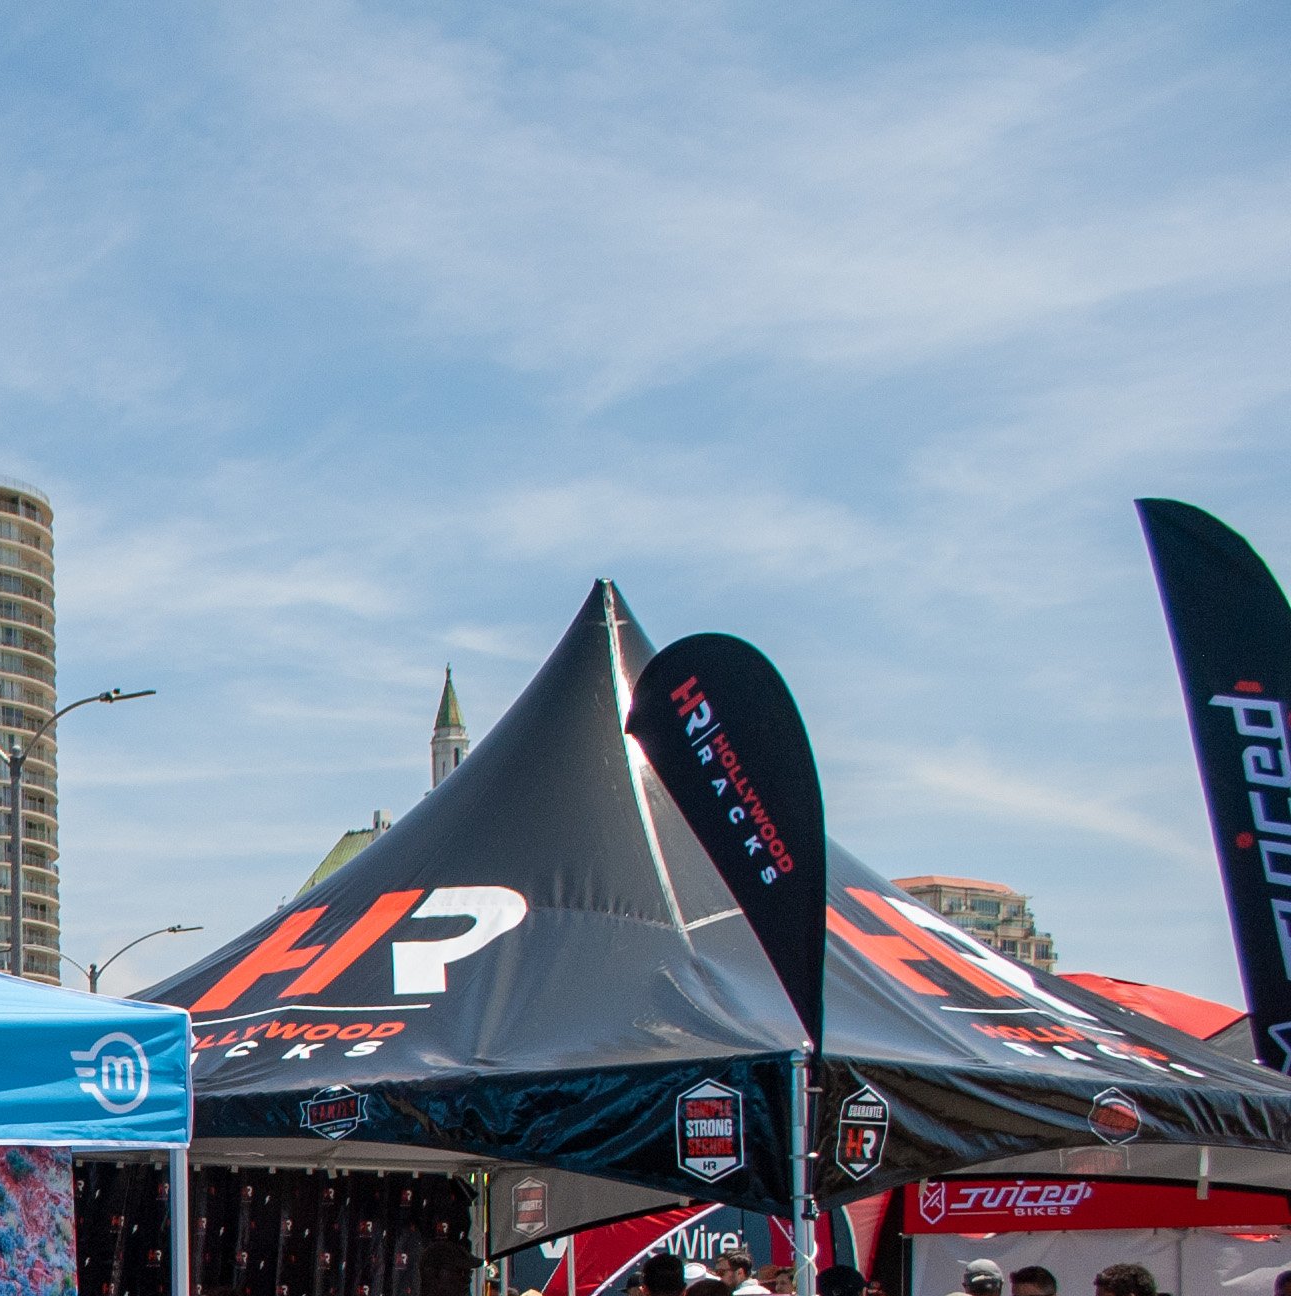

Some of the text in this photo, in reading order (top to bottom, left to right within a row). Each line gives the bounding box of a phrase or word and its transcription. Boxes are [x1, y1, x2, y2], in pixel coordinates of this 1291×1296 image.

[670, 675, 711, 737] HR
[697, 744, 777, 884] RACKS
[712, 733, 794, 874] HOLLYWOOD
[685, 1119, 732, 1137] STRONG
[1014, 1207, 1072, 1217] BIKES
